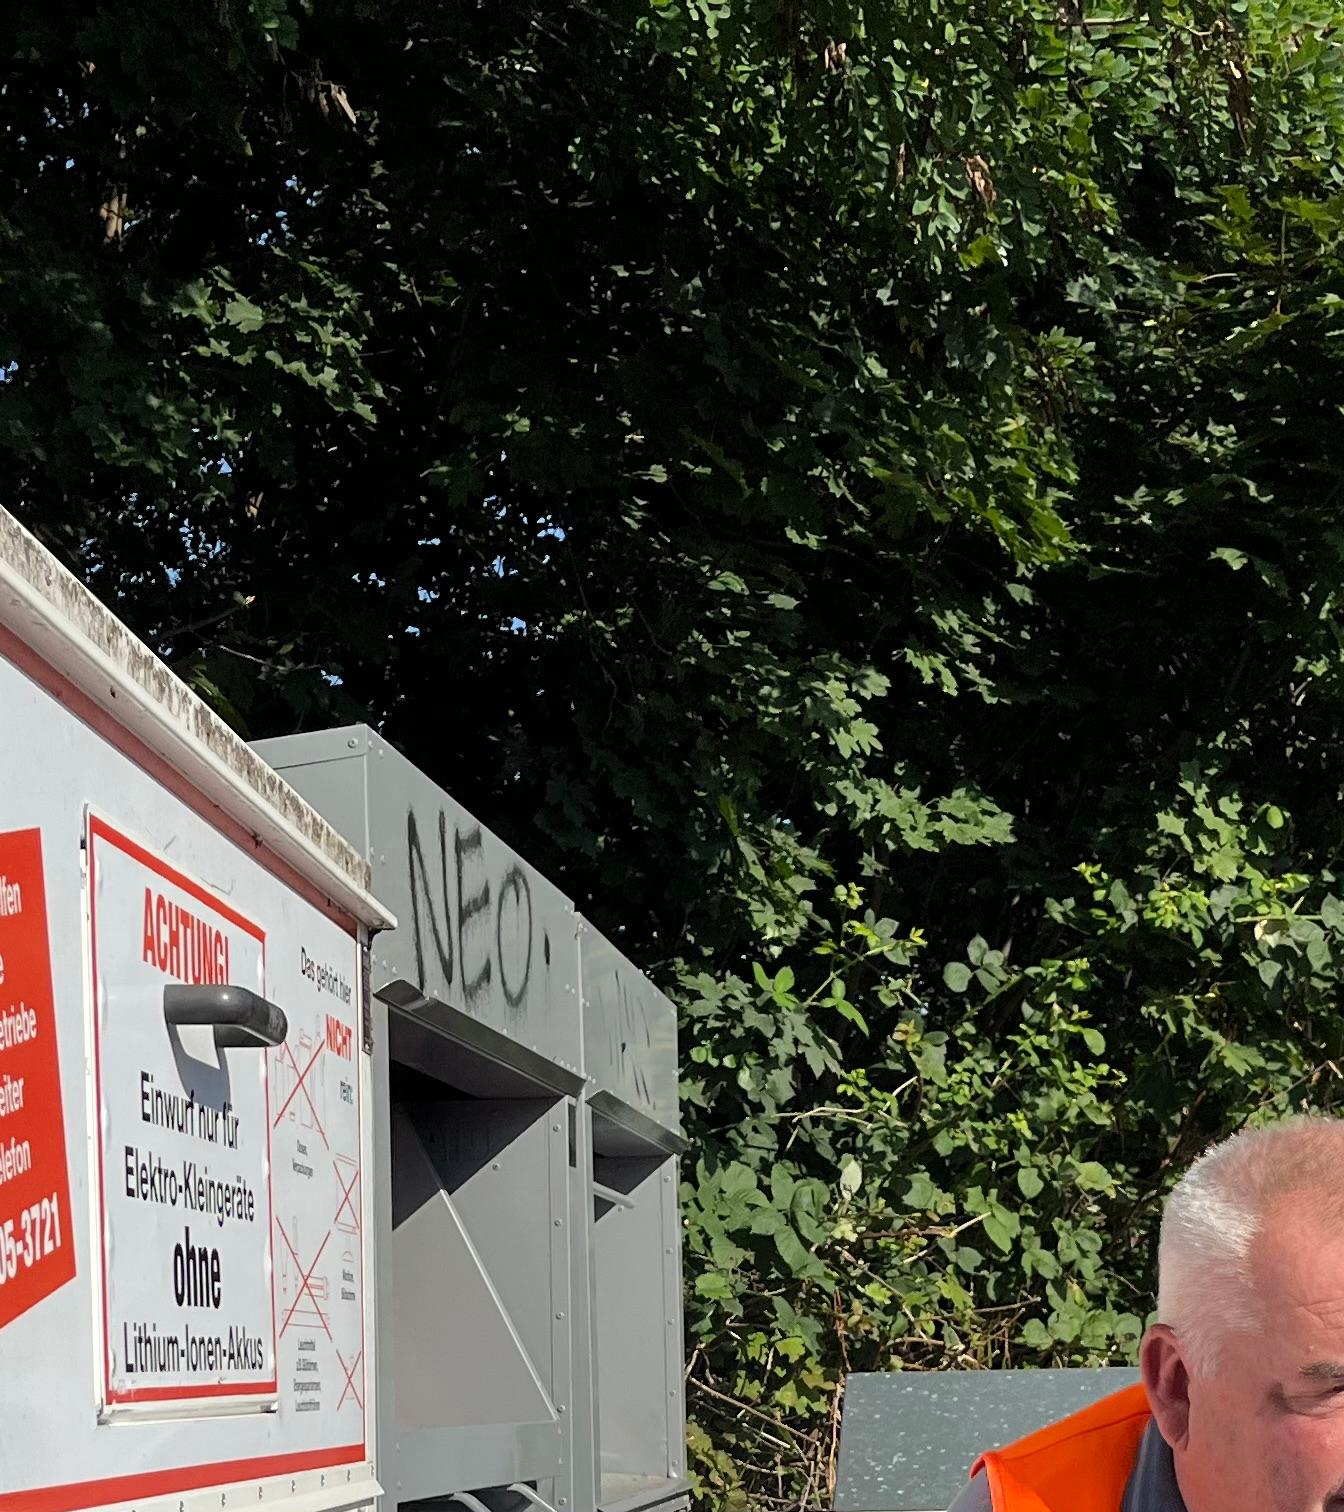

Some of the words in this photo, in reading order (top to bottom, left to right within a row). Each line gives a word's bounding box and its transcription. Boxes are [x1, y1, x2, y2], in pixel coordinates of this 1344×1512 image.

[301, 946, 315, 981] Das
[325, 1014, 352, 1062] NICHT
[141, 1070, 194, 1137] Einwurf
[198, 1104, 219, 1143] nur
[223, 1101, 239, 1149] für
[125, 1145, 255, 1228] Elektro-Kleingeräte
[174, 1225, 221, 1309] ohne
[124, 1321, 264, 1373] Lithium-Ionen-Akkus
